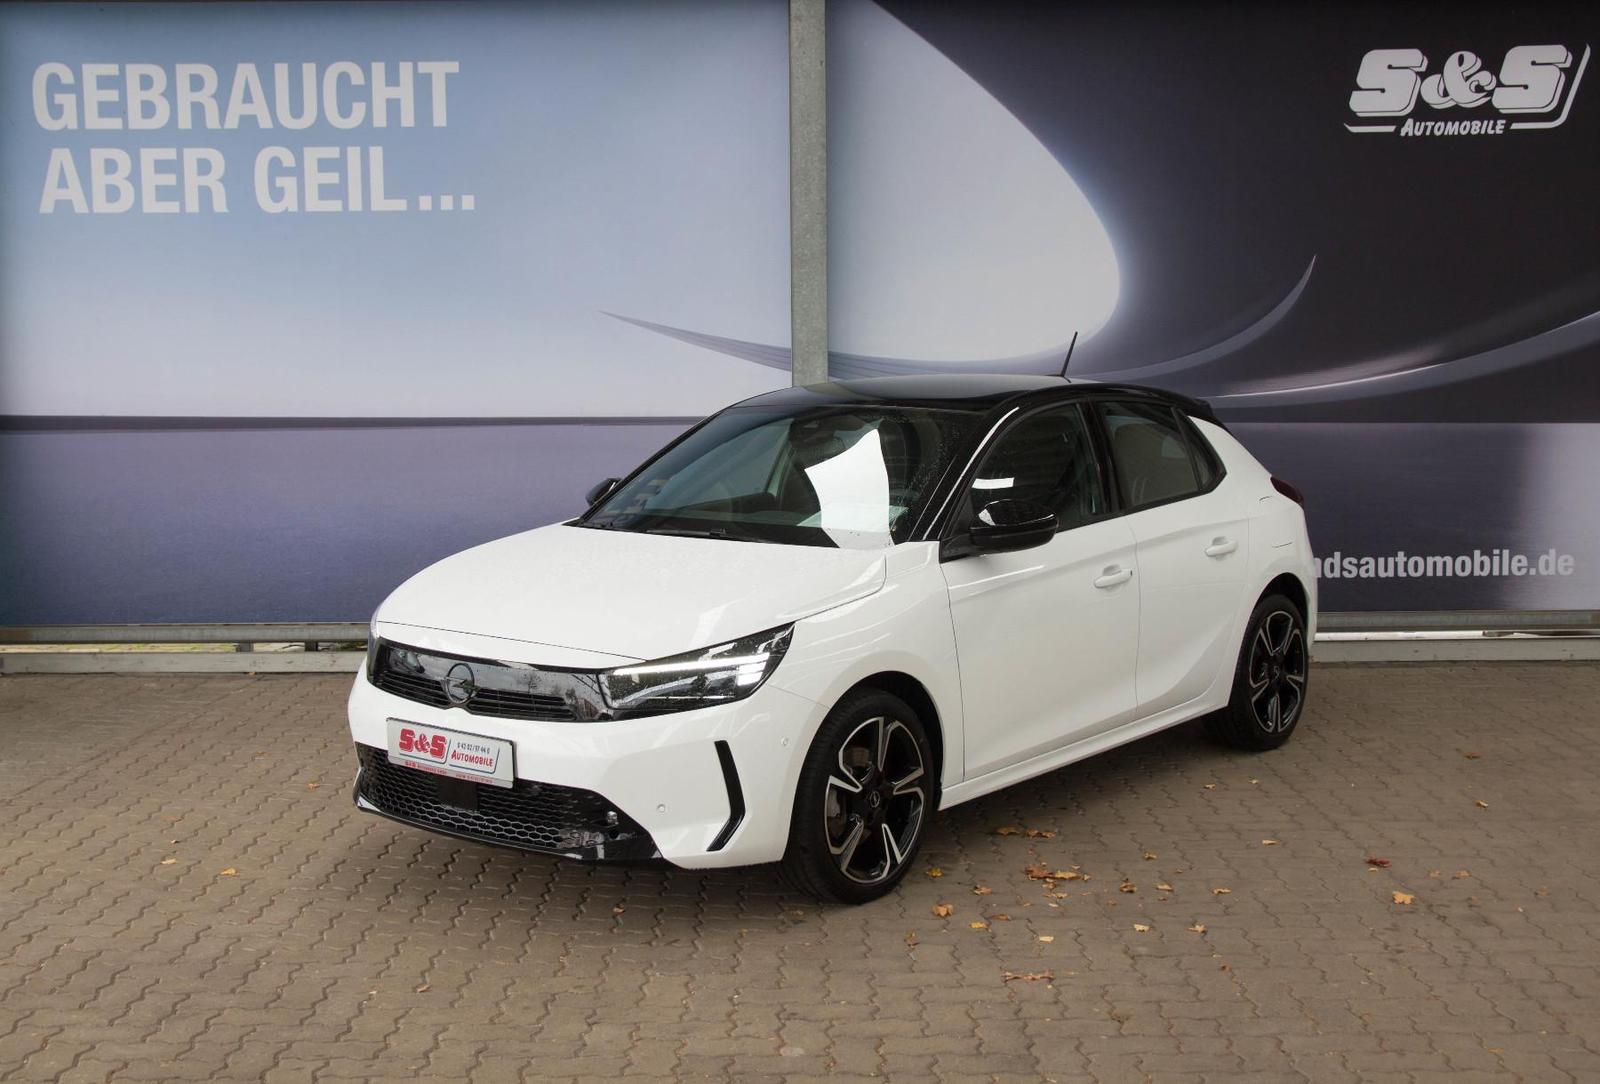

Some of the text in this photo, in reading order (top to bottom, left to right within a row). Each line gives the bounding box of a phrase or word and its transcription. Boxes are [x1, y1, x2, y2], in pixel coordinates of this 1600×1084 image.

[31, 60, 460, 131] GEBRAUCHT
[1348, 44, 1573, 117] S&S
[1399, 118, 1507, 137] AUTOMOBILE
[38, 145, 476, 214] ABER GEIL...
[398, 728, 447, 760] S&S
[451, 749, 494, 767] AUTOMOBILE
